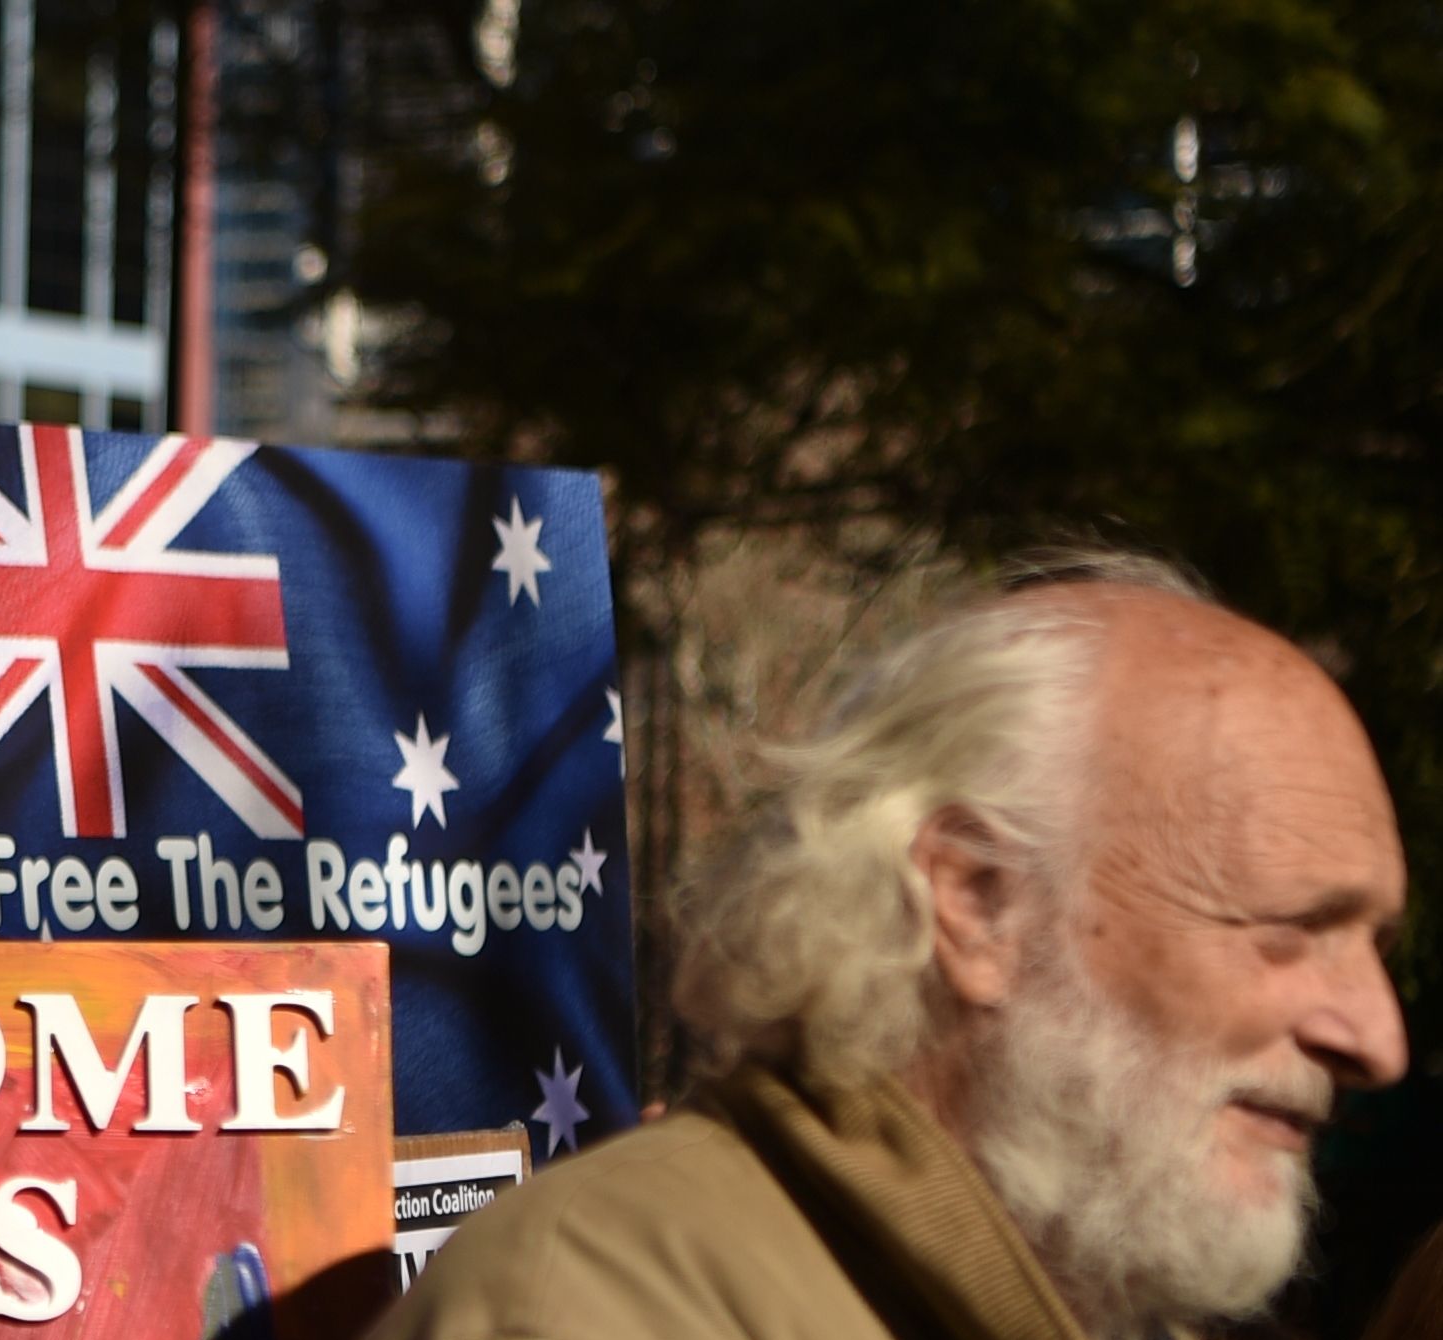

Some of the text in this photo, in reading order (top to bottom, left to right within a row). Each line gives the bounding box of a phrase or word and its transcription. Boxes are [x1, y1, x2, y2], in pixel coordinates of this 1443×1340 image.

[157, 832, 284, 931] The
[307, 833, 585, 957] Refugees
[392, 1191, 430, 1220] ction
